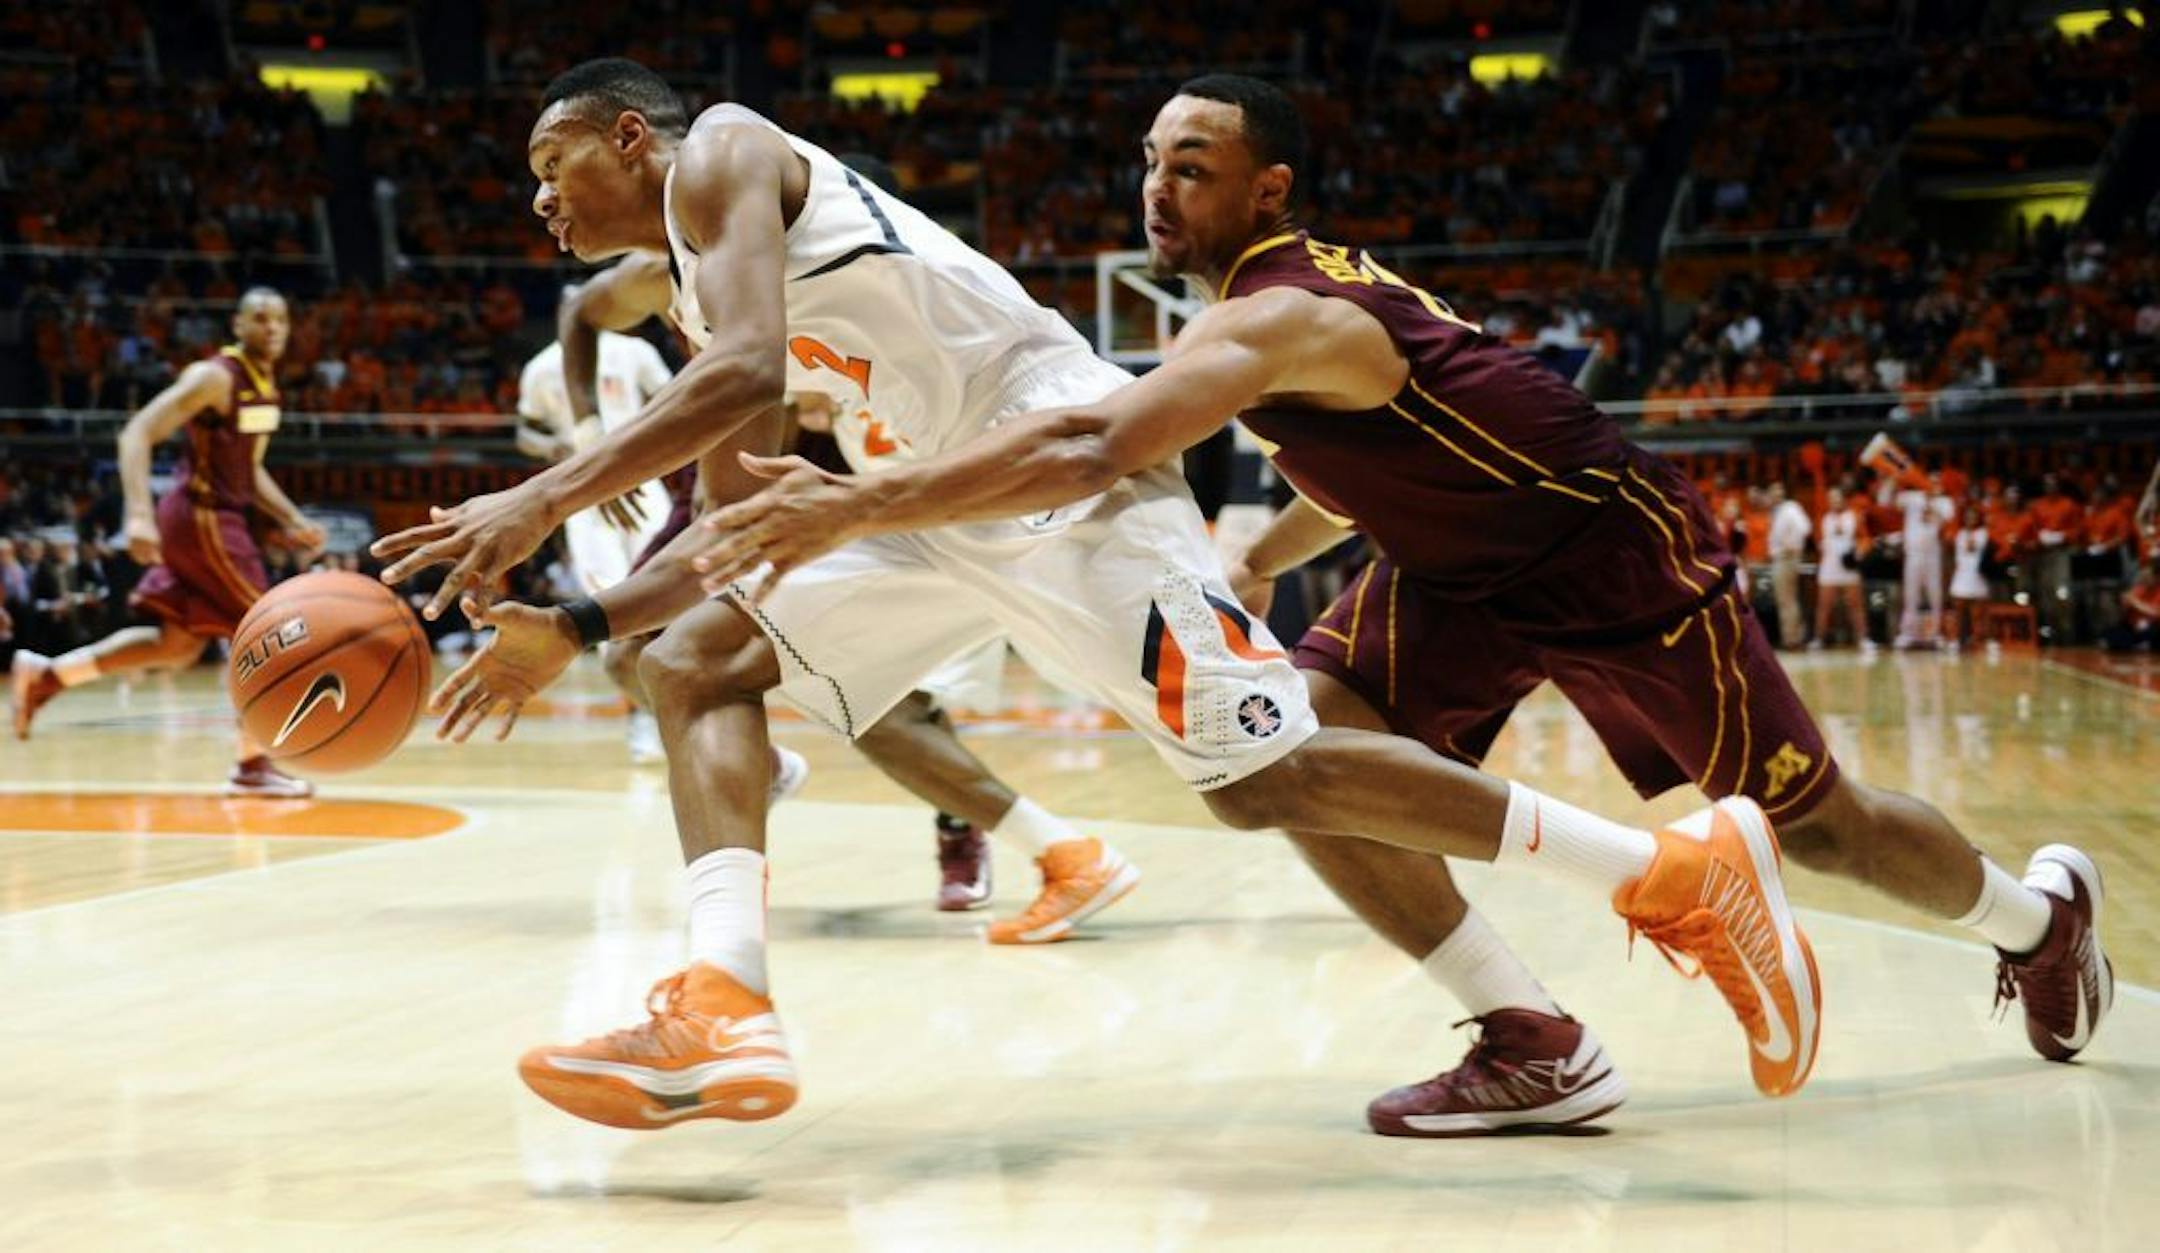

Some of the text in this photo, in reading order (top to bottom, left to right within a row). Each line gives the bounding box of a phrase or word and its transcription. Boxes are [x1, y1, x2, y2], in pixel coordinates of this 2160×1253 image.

[788, 335, 871, 402] 2
[236, 617, 307, 686] ELITE
[1764, 742, 1812, 800] M
